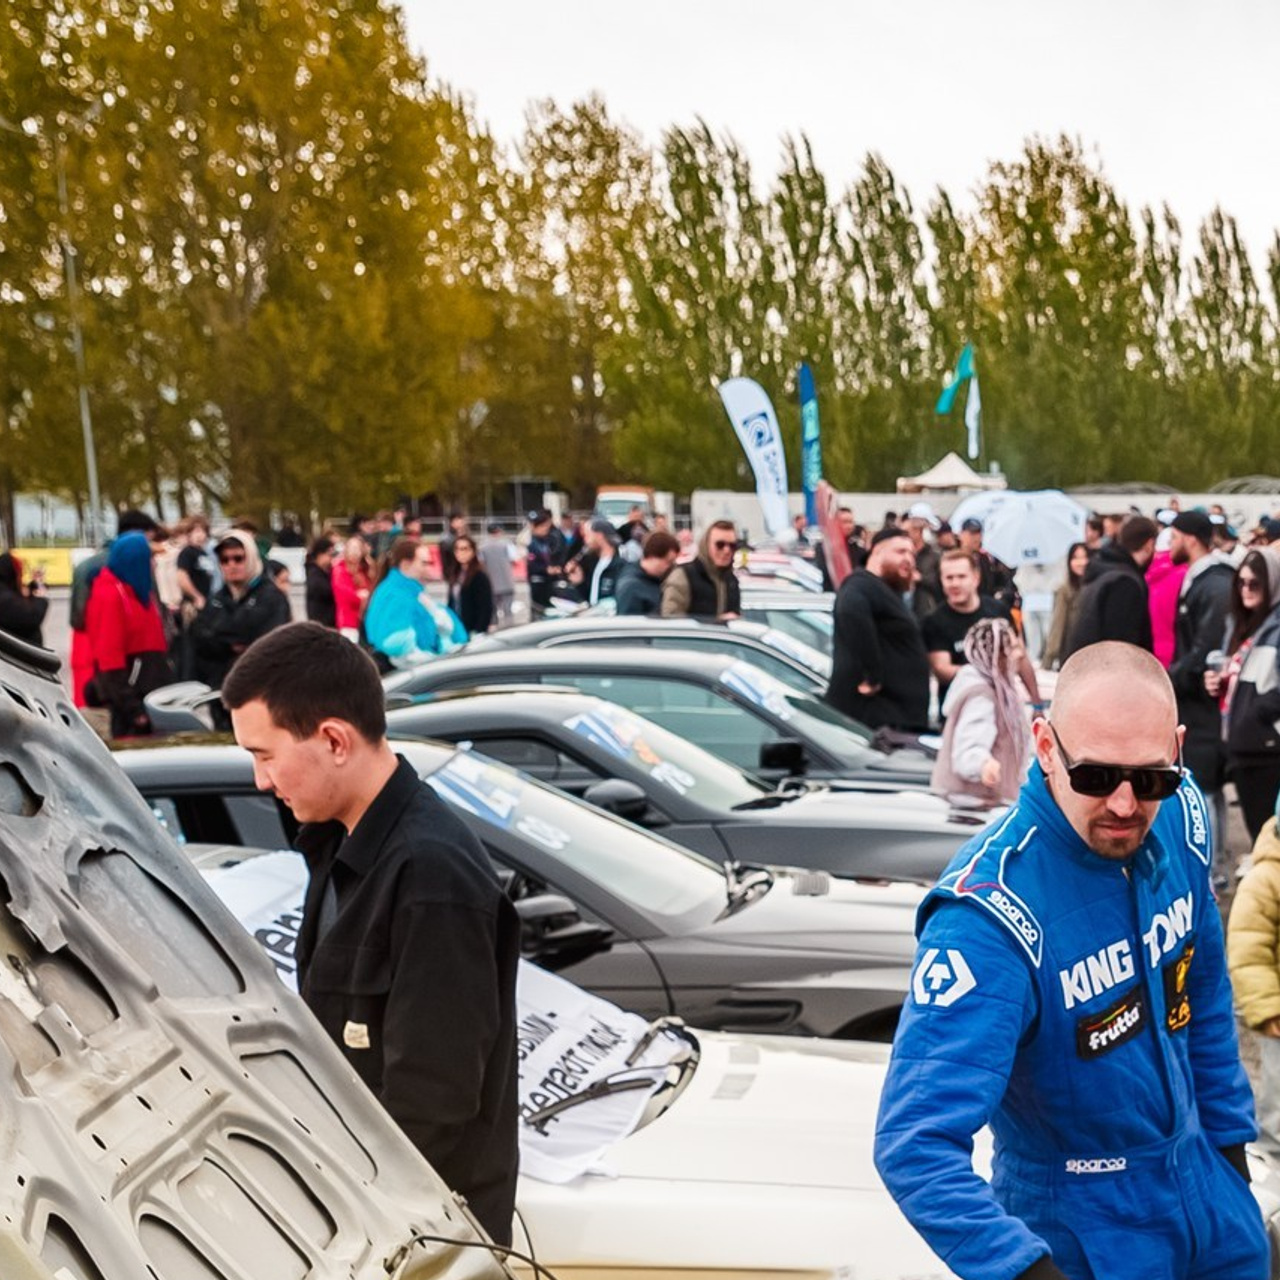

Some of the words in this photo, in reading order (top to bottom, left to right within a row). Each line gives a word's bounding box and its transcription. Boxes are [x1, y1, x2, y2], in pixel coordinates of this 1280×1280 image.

[986, 890, 1039, 946] sparco
[1059, 938, 1136, 1010] KING
[1142, 889, 1194, 969] TONY
[1065, 1156, 1127, 1176] sparco
